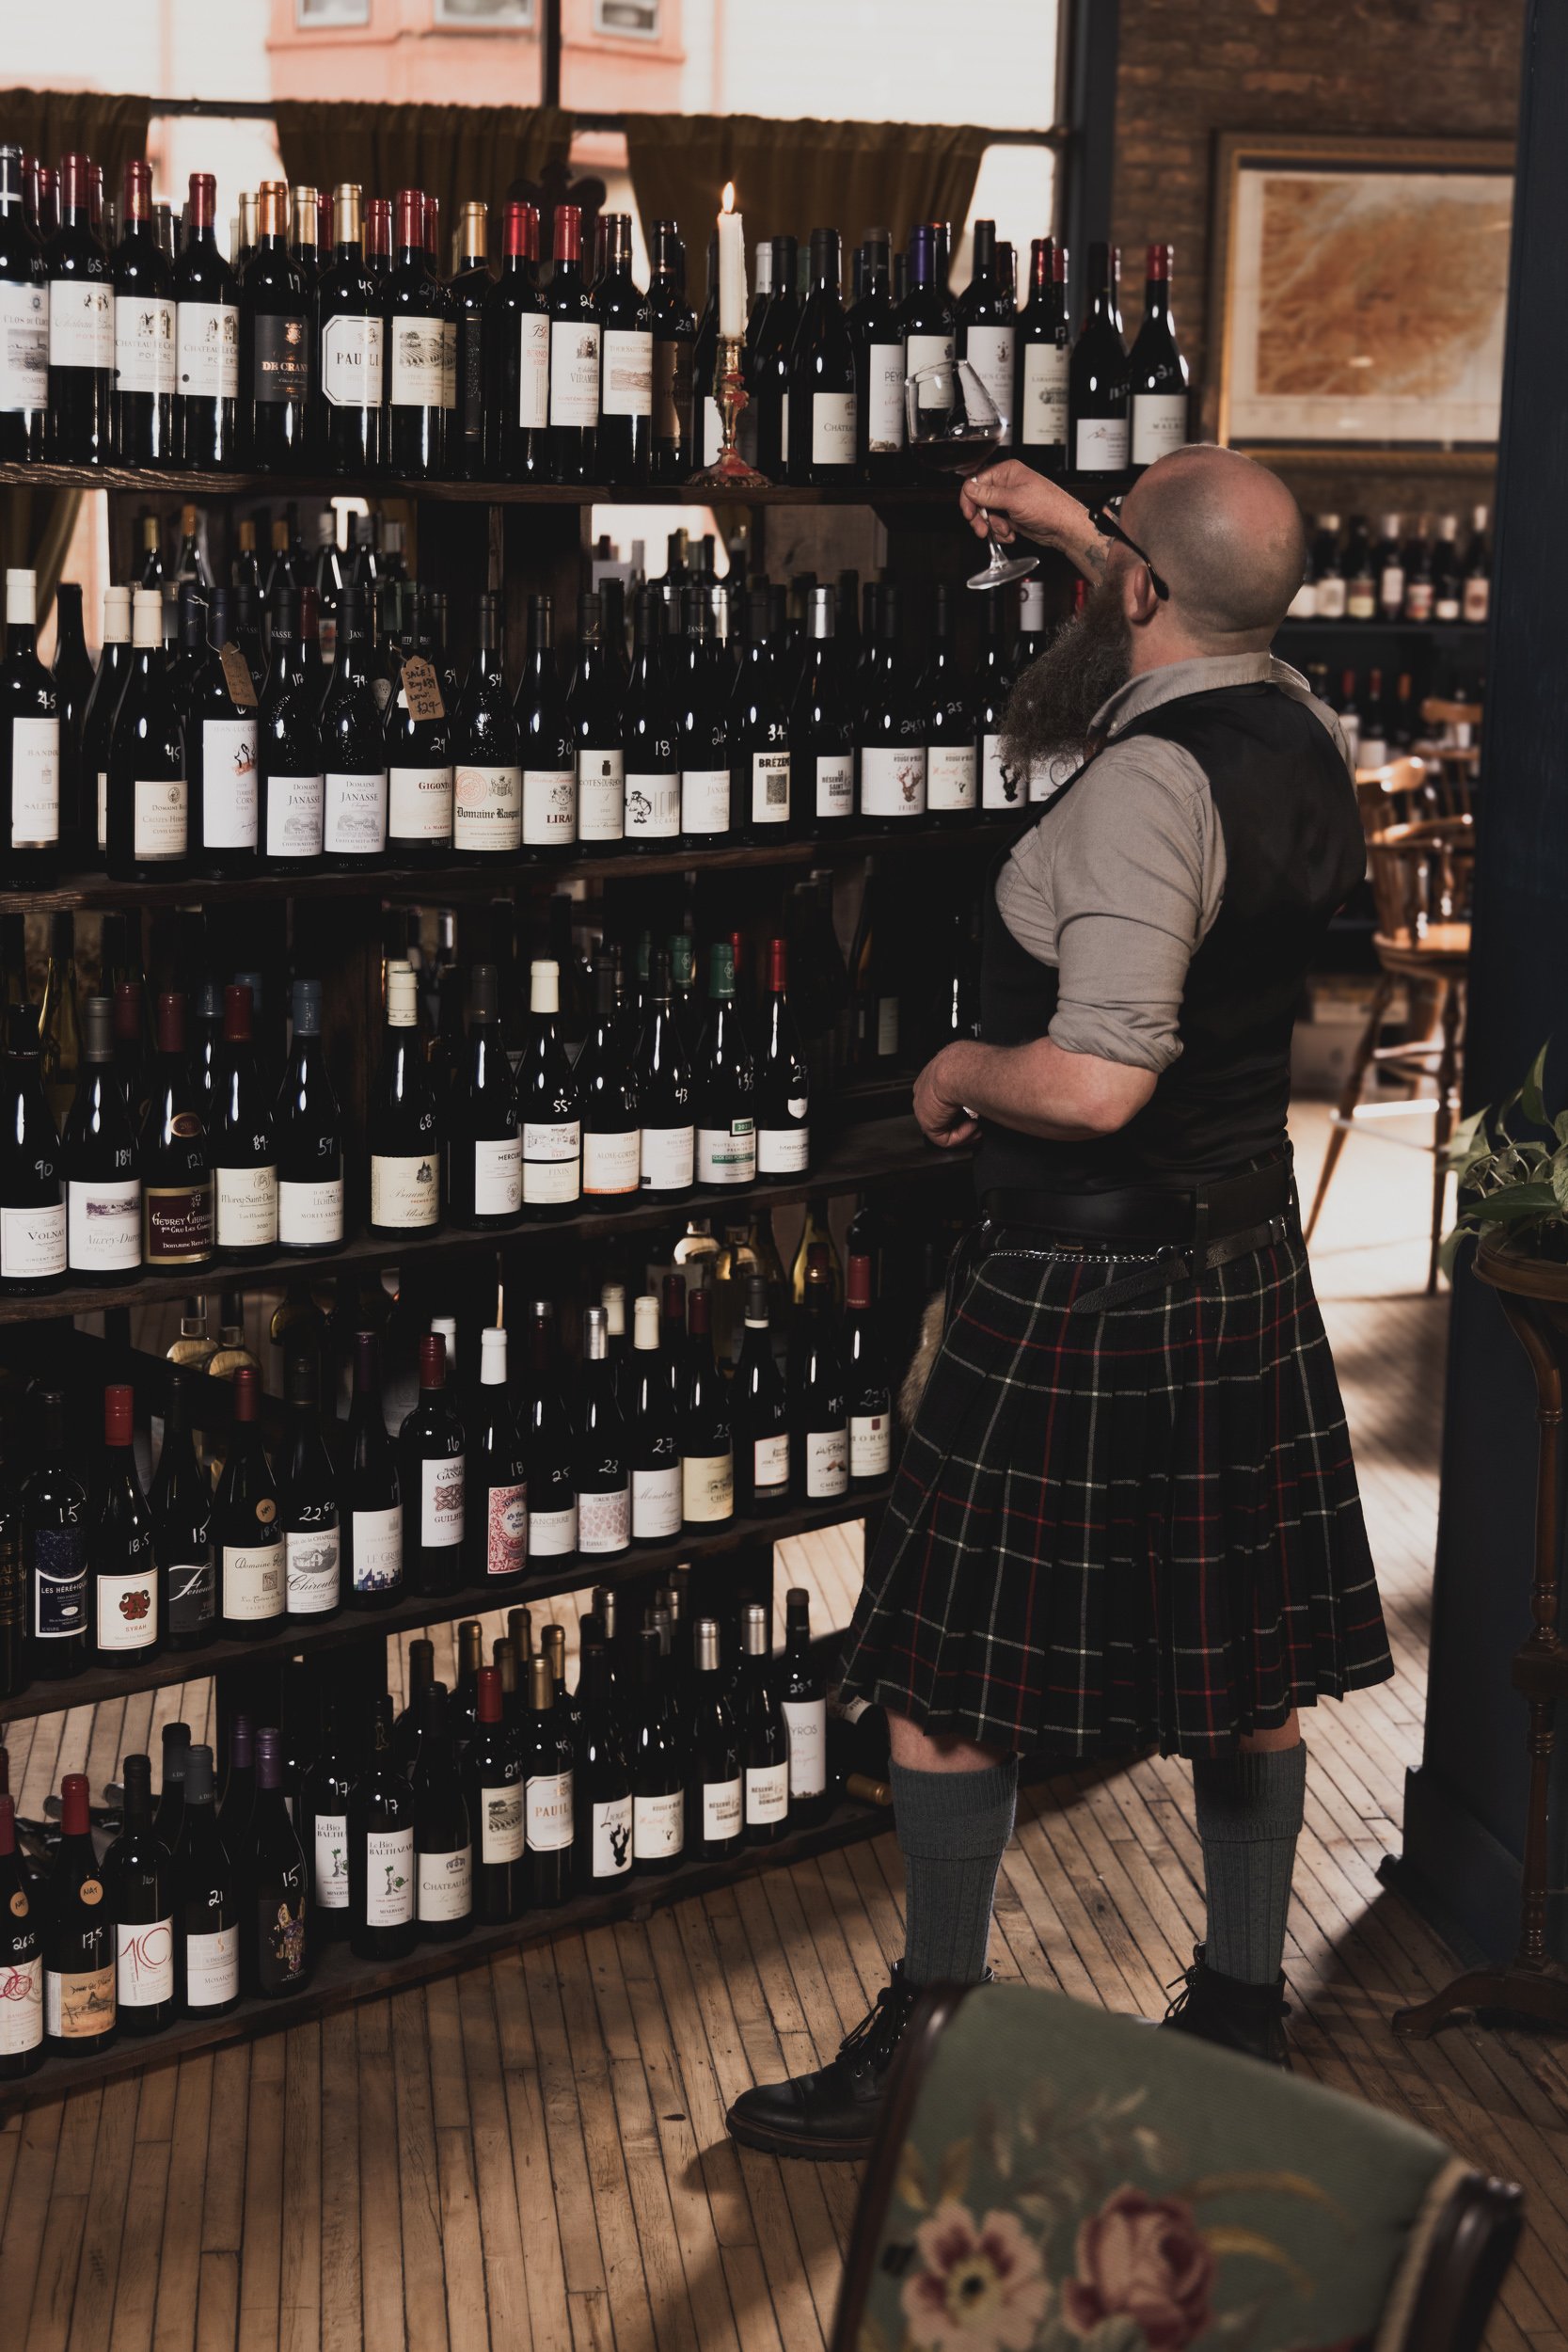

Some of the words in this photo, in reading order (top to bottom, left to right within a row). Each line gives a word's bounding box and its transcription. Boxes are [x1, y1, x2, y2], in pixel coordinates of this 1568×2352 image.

[357, 278, 374, 296] 45
[655, 739, 671, 756] 18
[341, 791, 379, 803] JANASSE
[675, 1088, 688, 1104] 43
[420, 1113, 433, 1131] 68
[317, 1136, 333, 1156] 59
[35, 1159, 54, 1180] 90
[511, 1460, 524, 1477] 18
[598, 1459, 619, 1473] 23
[59, 1502, 81, 1523] 15
[128, 1532, 150, 1555] 18.5
[125, 1624, 147, 1633] SYRAH
[335, 1781, 349, 1798] 17
[385, 1798, 400, 1815] 17
[379, 1840, 393, 1849] Bio
[282, 1863, 301, 1888] 15
[209, 1889, 224, 1907] 21
[83, 1927, 103, 1950] 17.5
